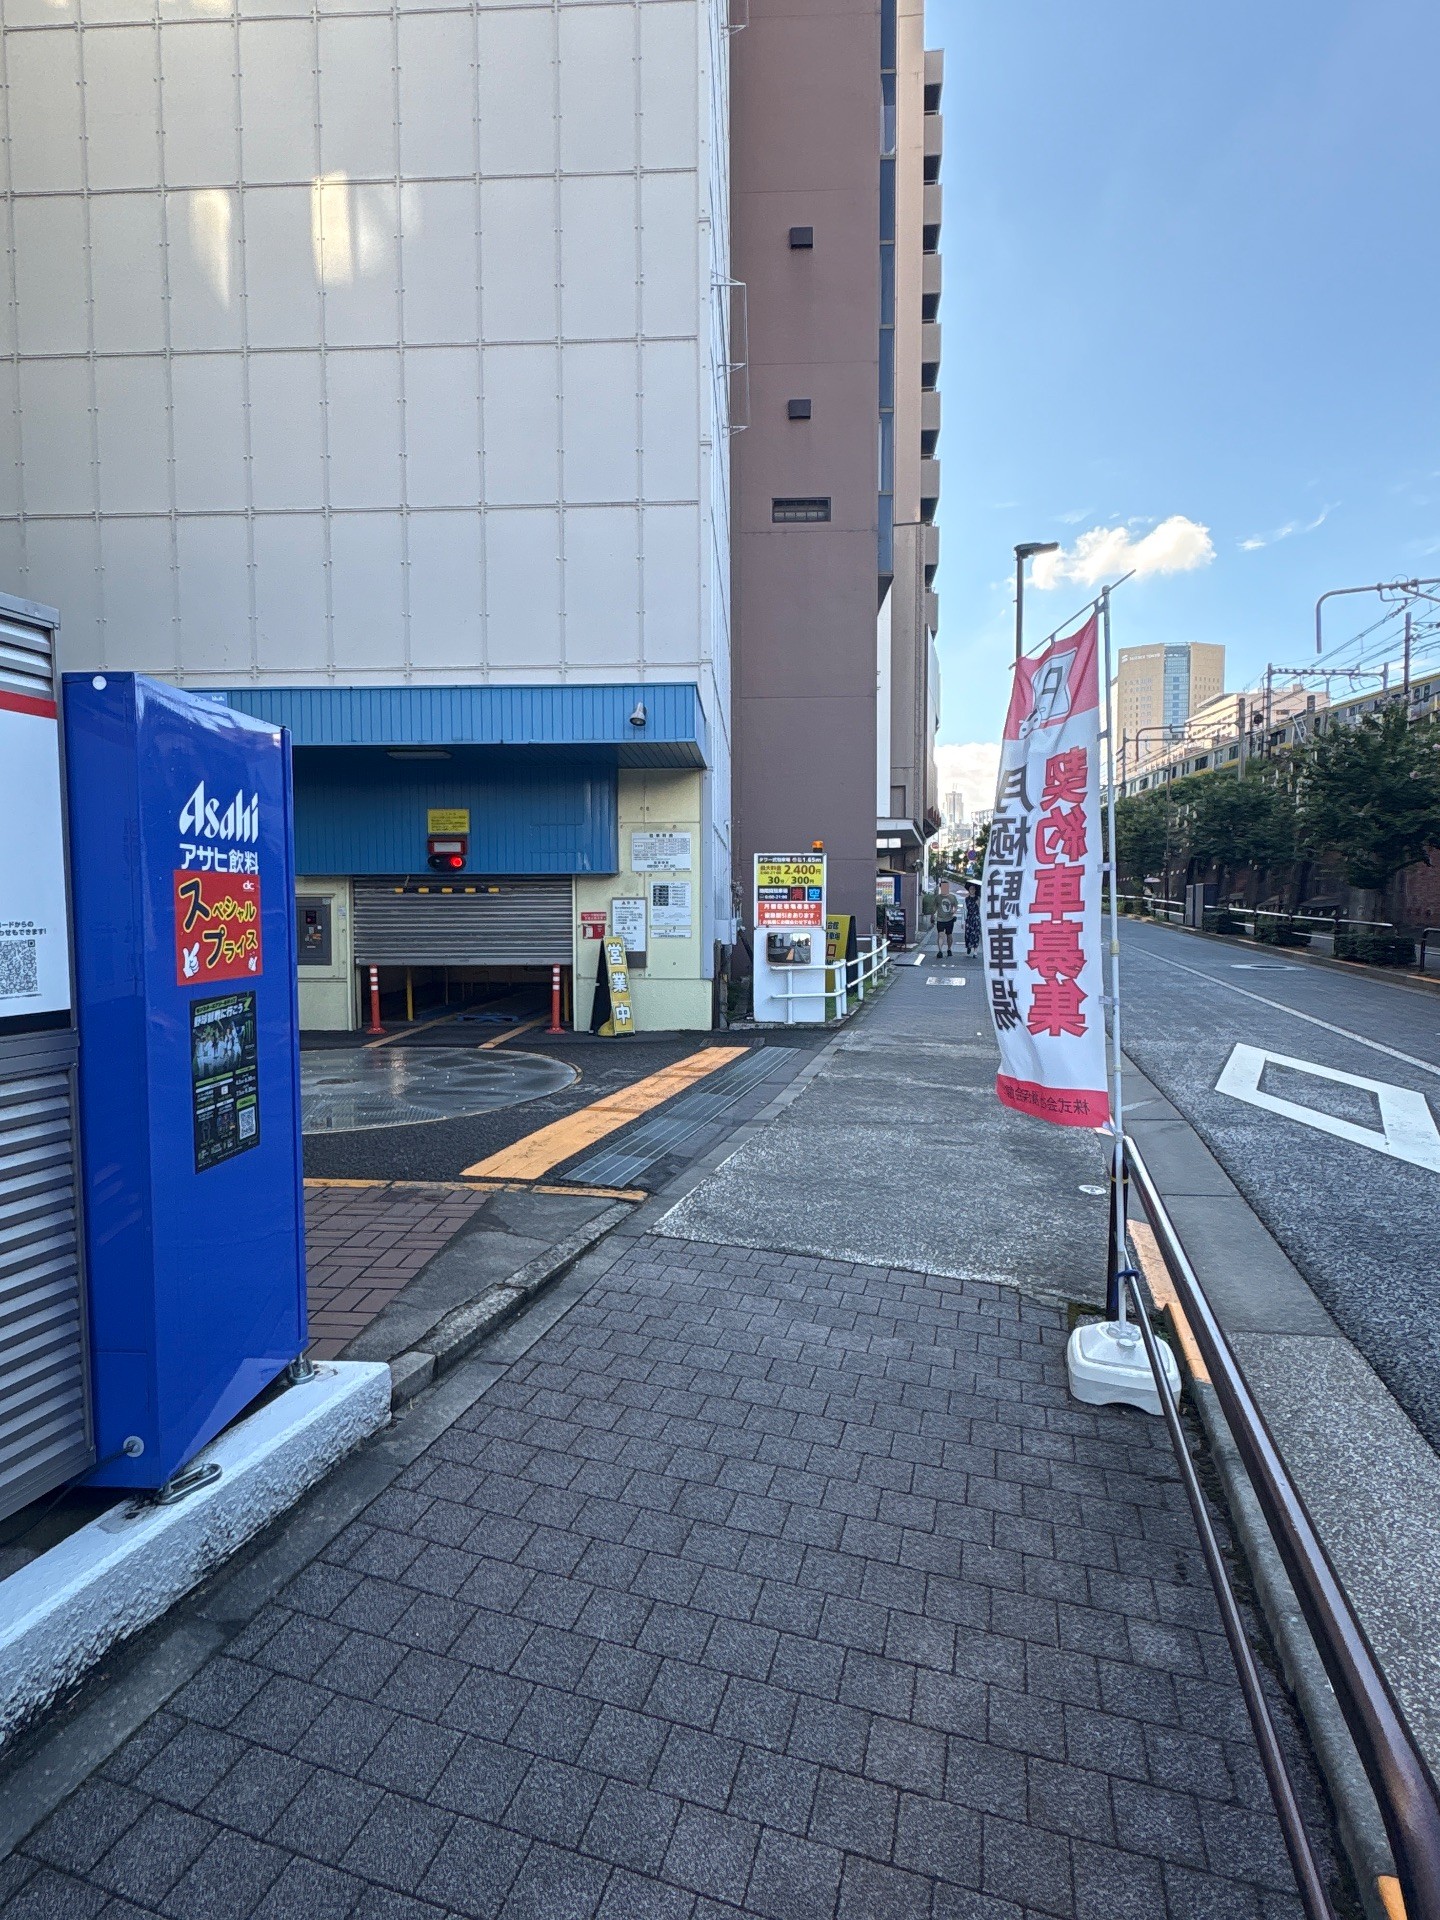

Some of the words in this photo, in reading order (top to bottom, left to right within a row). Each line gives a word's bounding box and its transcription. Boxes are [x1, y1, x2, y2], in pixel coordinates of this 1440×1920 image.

[179, 780, 259, 844] Asahi
[179, 843, 259, 875] アサヒ飲料
[179, 878, 257, 933] スペシャル
[809, 888, 820, 900] 空
[202, 924, 258, 969] プライス
[607, 942, 631, 1026] 営業中
